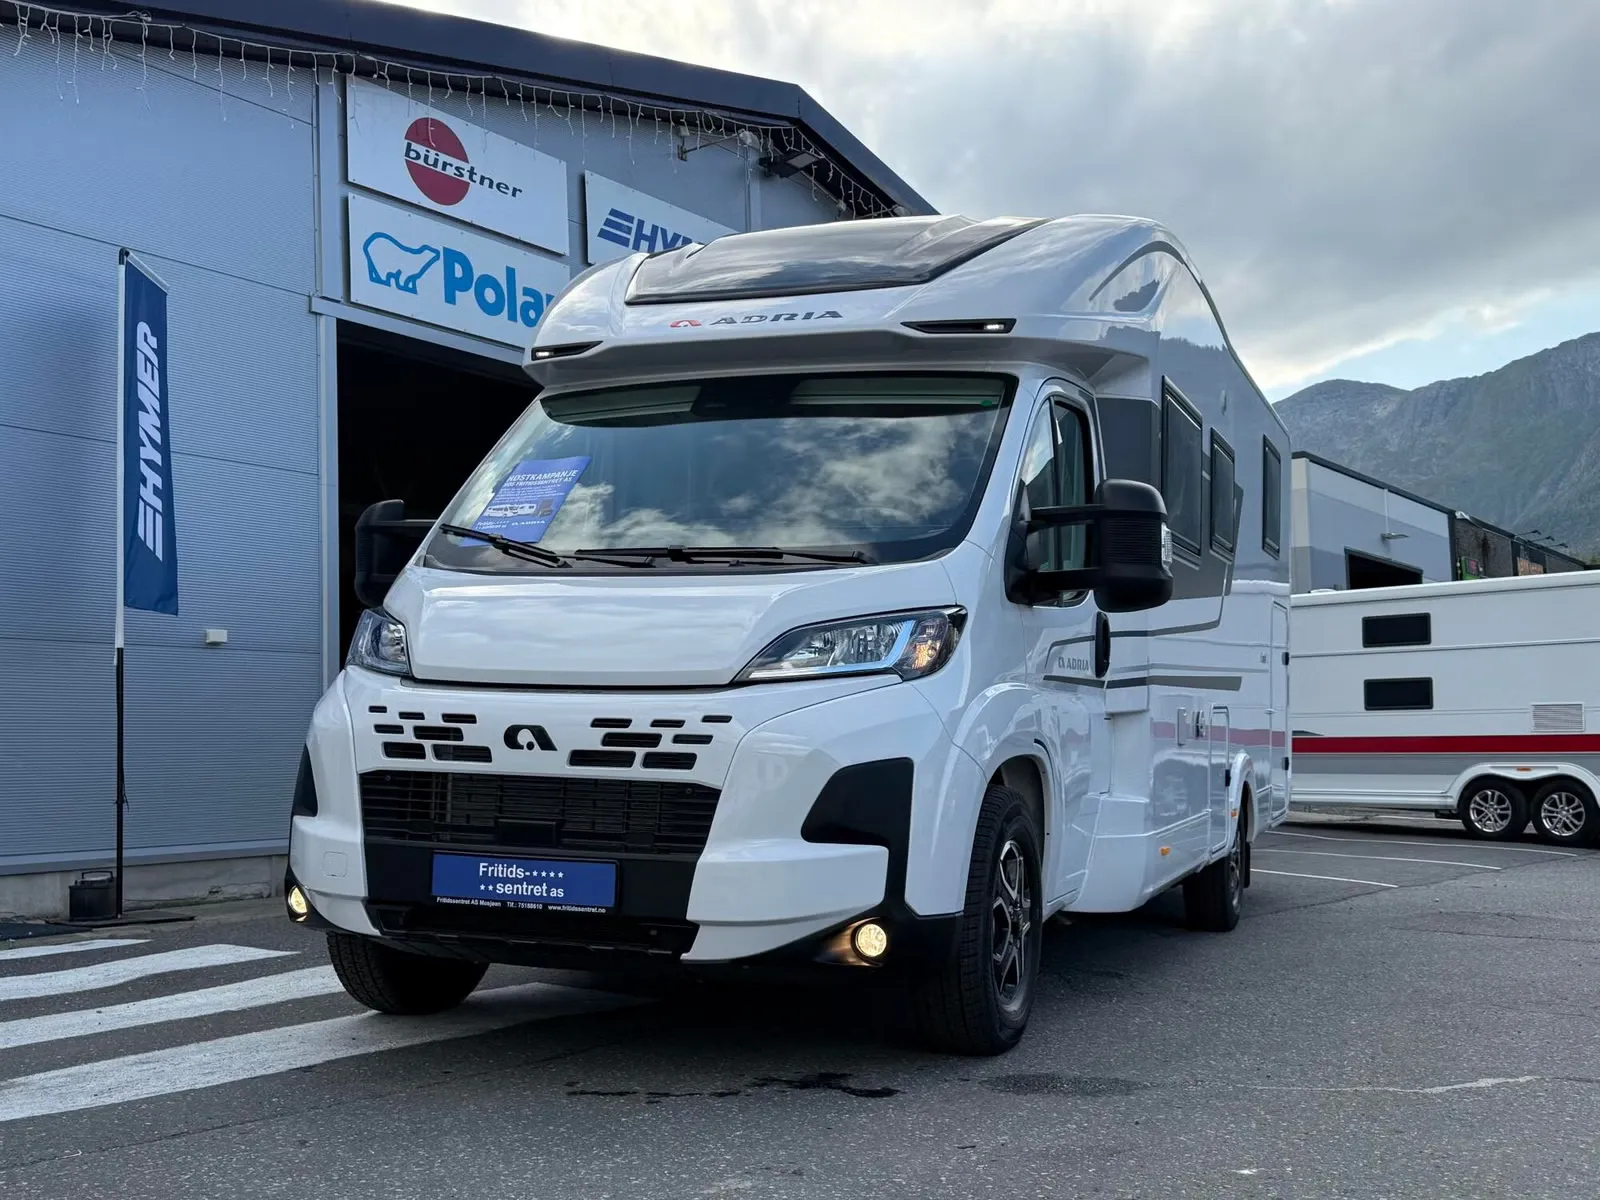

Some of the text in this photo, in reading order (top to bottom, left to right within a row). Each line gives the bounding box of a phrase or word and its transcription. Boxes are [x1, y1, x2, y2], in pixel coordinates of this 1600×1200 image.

[404, 141, 523, 198] bürstner
[710, 310, 844, 325] ADRIA
[136, 320, 163, 511] HYMER
[1066, 657, 1089, 671] ADRIA
[496, 881, 564, 897] sentret as
